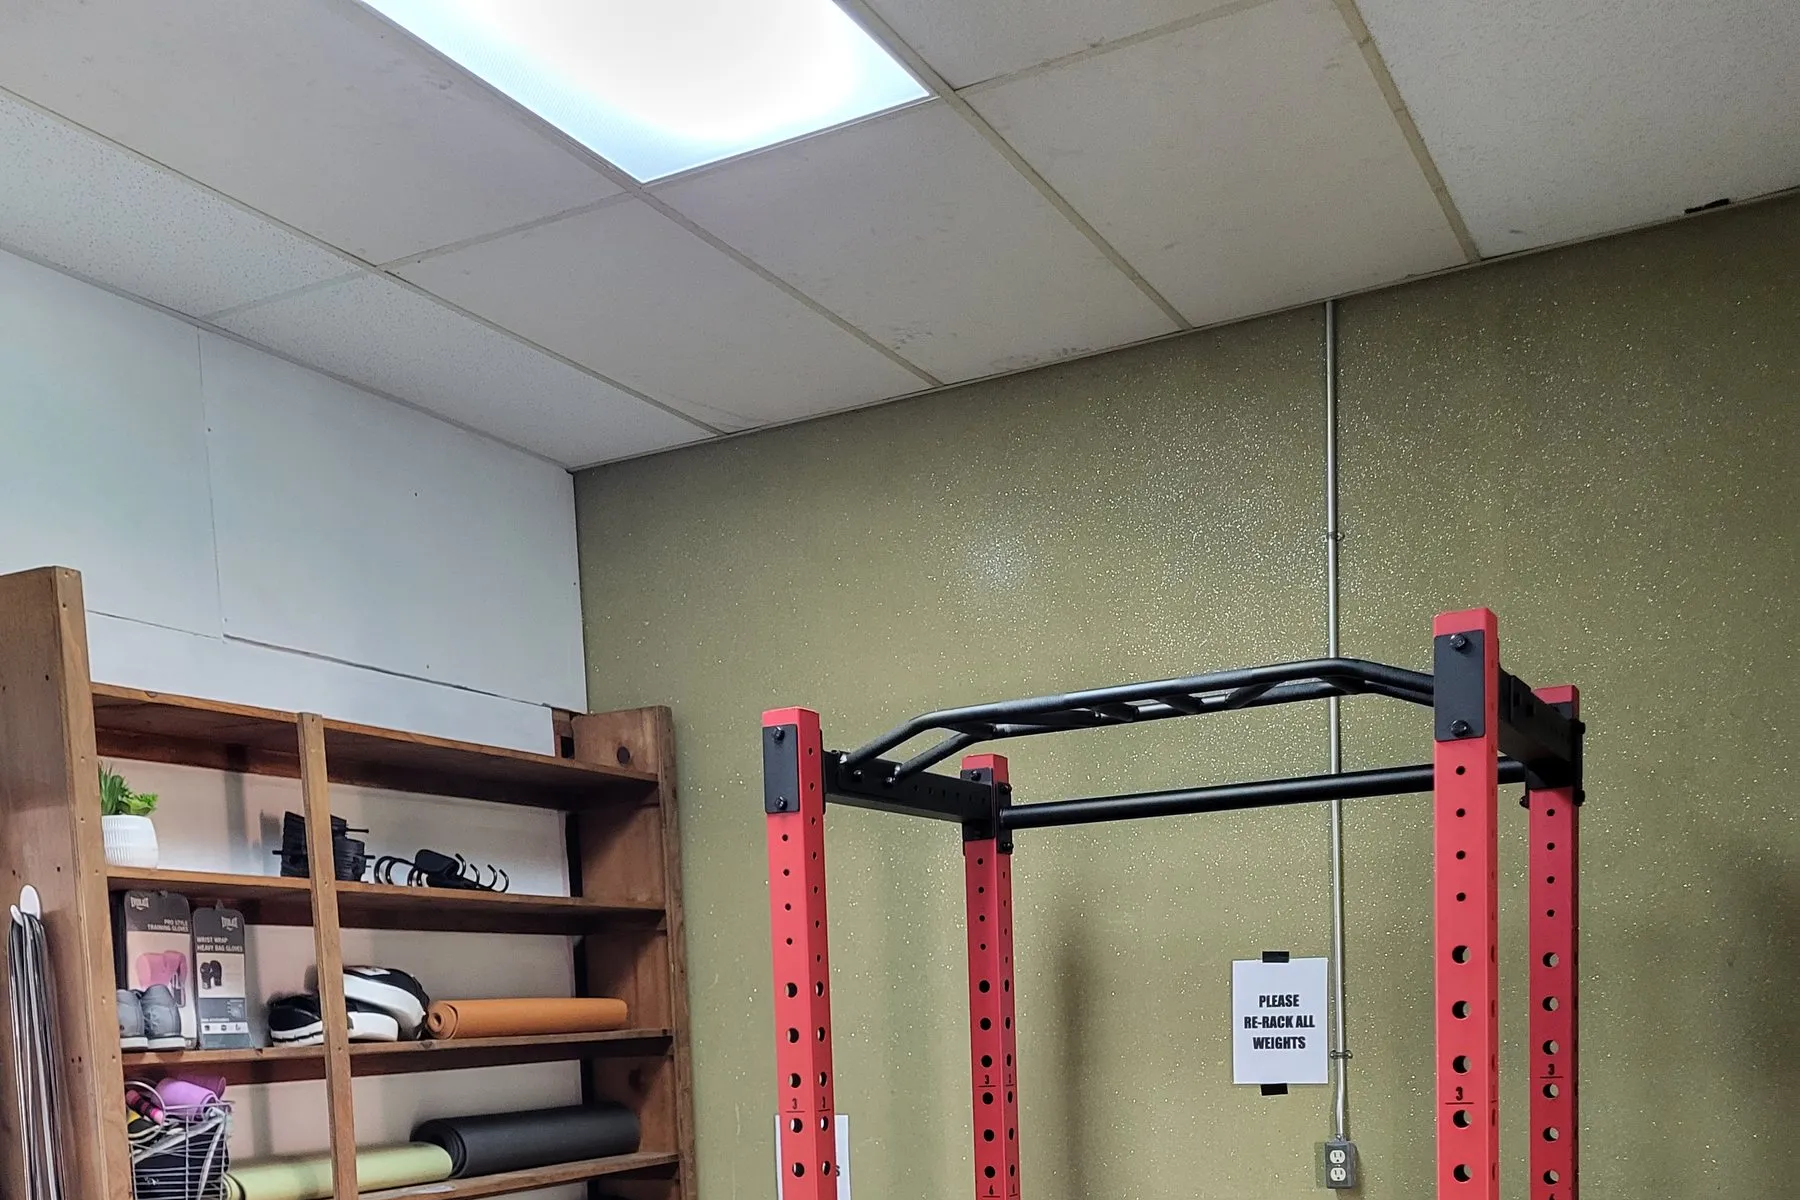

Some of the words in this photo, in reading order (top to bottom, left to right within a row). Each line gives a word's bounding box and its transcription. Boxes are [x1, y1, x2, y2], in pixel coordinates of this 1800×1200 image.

[1259, 995, 1299, 1008] PLEASE
[1244, 1016, 1293, 1029] RE-RACK
[1296, 1015, 1315, 1028] ALL
[1253, 1036, 1306, 1049] WEIGHTS
[1456, 1086, 1463, 1101] 3
[792, 1097, 798, 1110] 3
